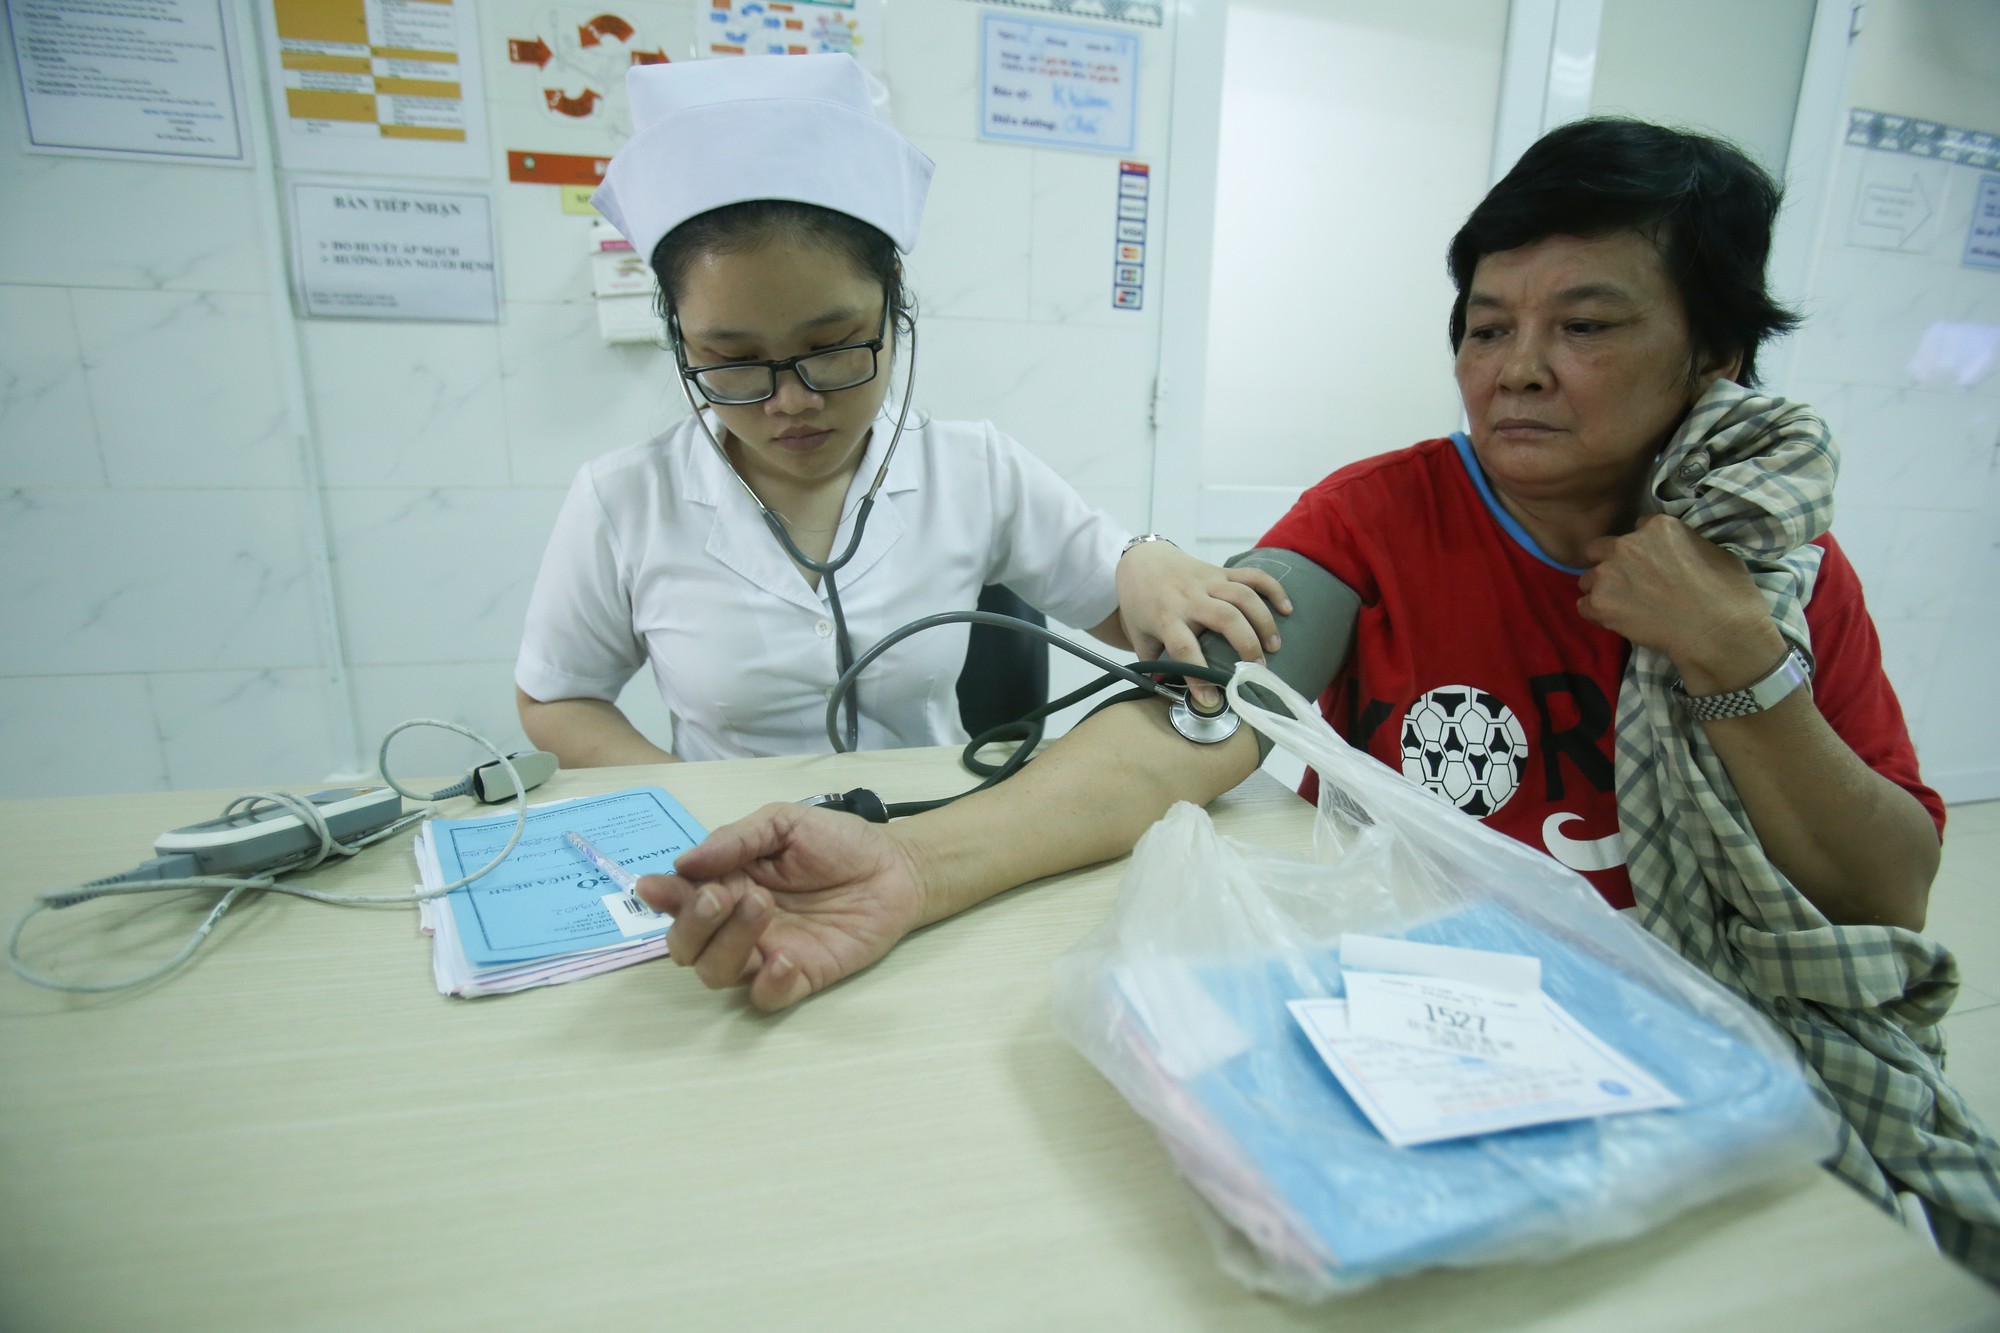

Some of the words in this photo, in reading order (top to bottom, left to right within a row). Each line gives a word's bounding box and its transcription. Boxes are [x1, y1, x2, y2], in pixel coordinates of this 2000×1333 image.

[638, 845, 681, 861] KHÁM
[489, 883, 533, 895] BỆNH
[1424, 1003, 1487, 1033] 1527
